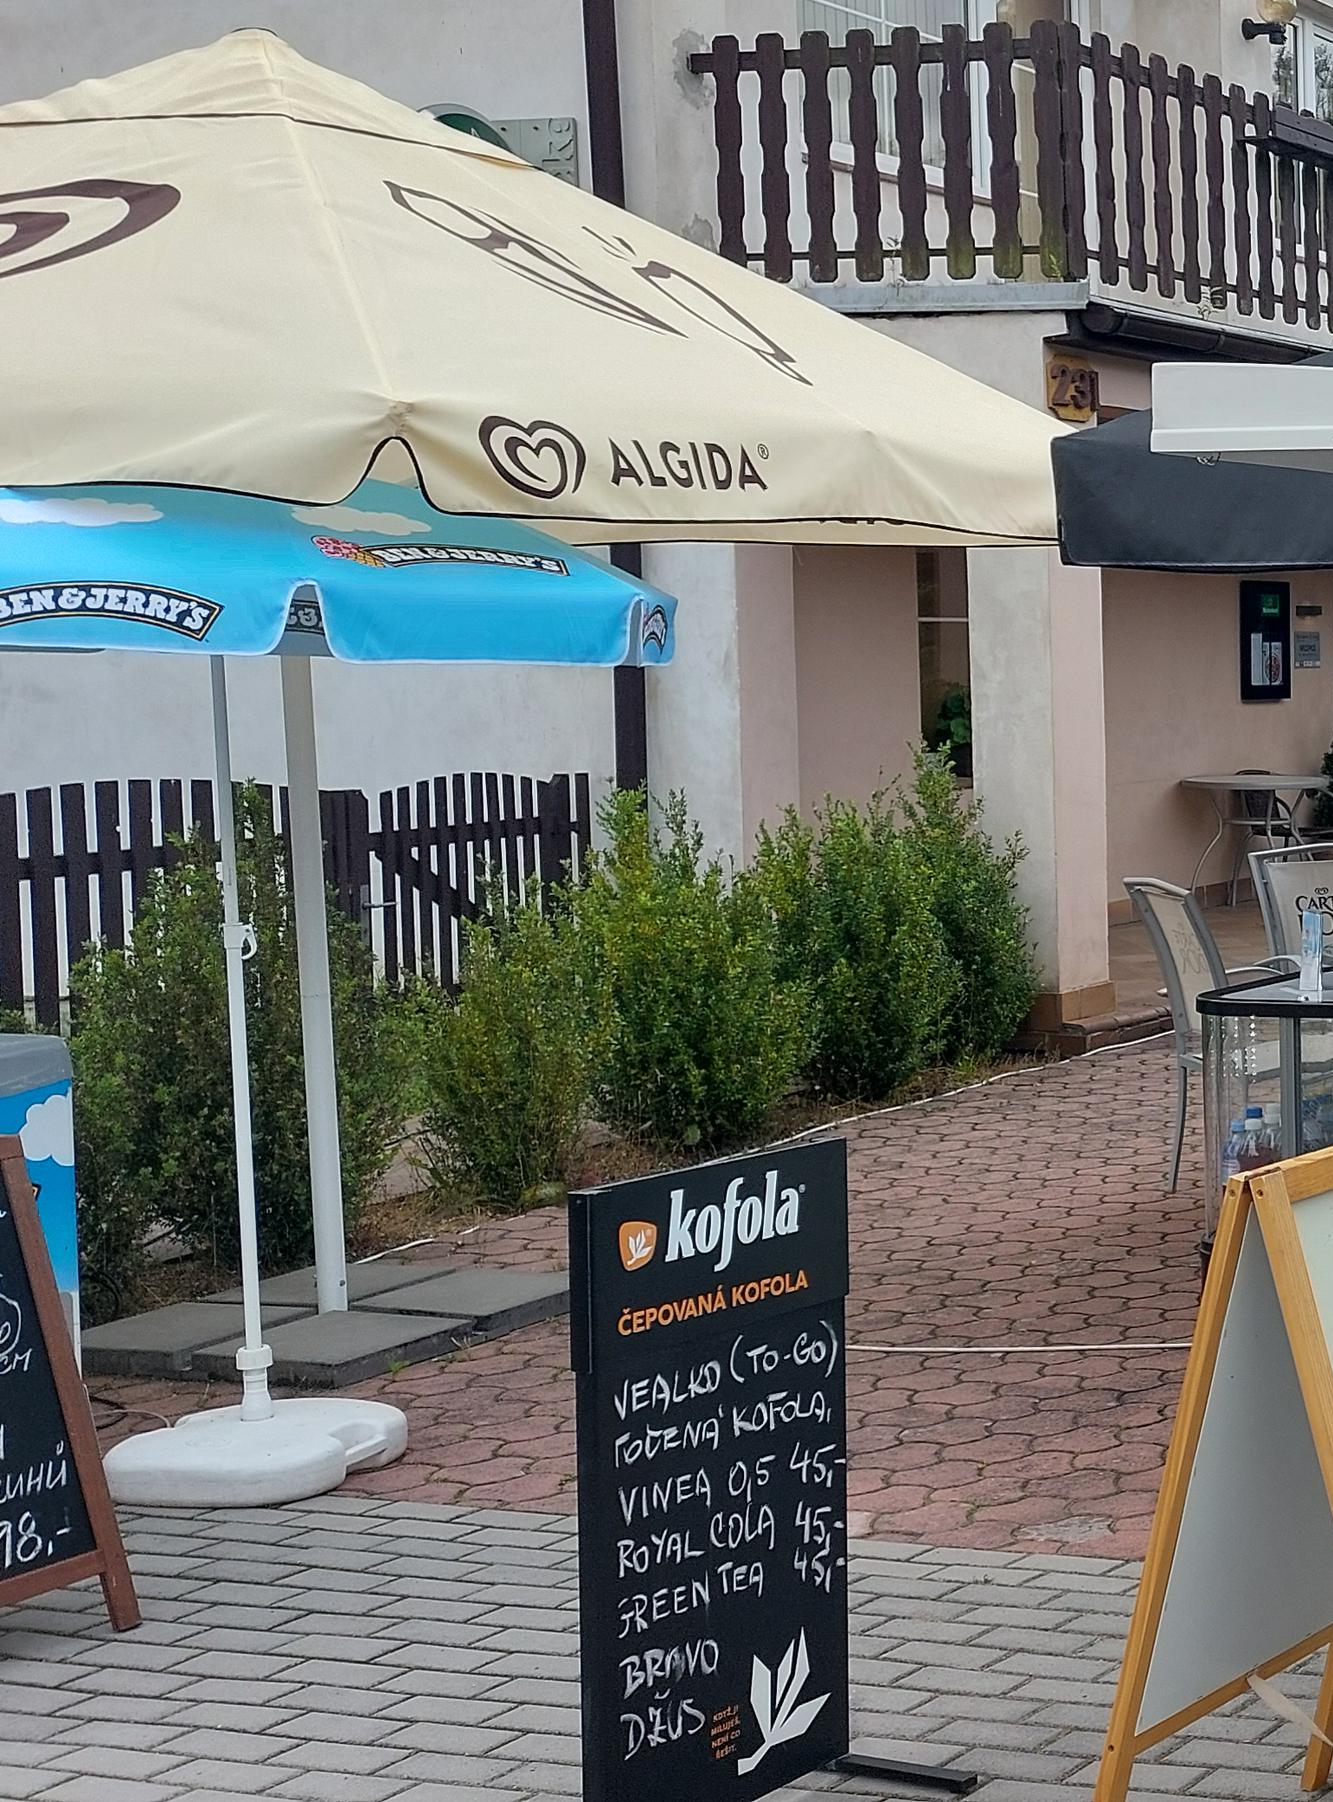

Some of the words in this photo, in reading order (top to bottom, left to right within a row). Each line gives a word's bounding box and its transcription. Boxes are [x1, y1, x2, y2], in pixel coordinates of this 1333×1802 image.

[608, 436, 768, 491] ALGIDA
[664, 1170, 800, 1272] kofola
[617, 1284, 727, 1336] ČEPOVANÁ
[731, 1269, 809, 1308] KOFOLA
[730, 1319, 838, 1383] (TO-GO)
[617, 1466, 711, 1527] VINEA
[616, 1528, 705, 1579] ROYAL
[709, 1501, 776, 1550] COLA
[717, 1561, 764, 1598] TEA
[618, 1638, 720, 1700] BRAVO
